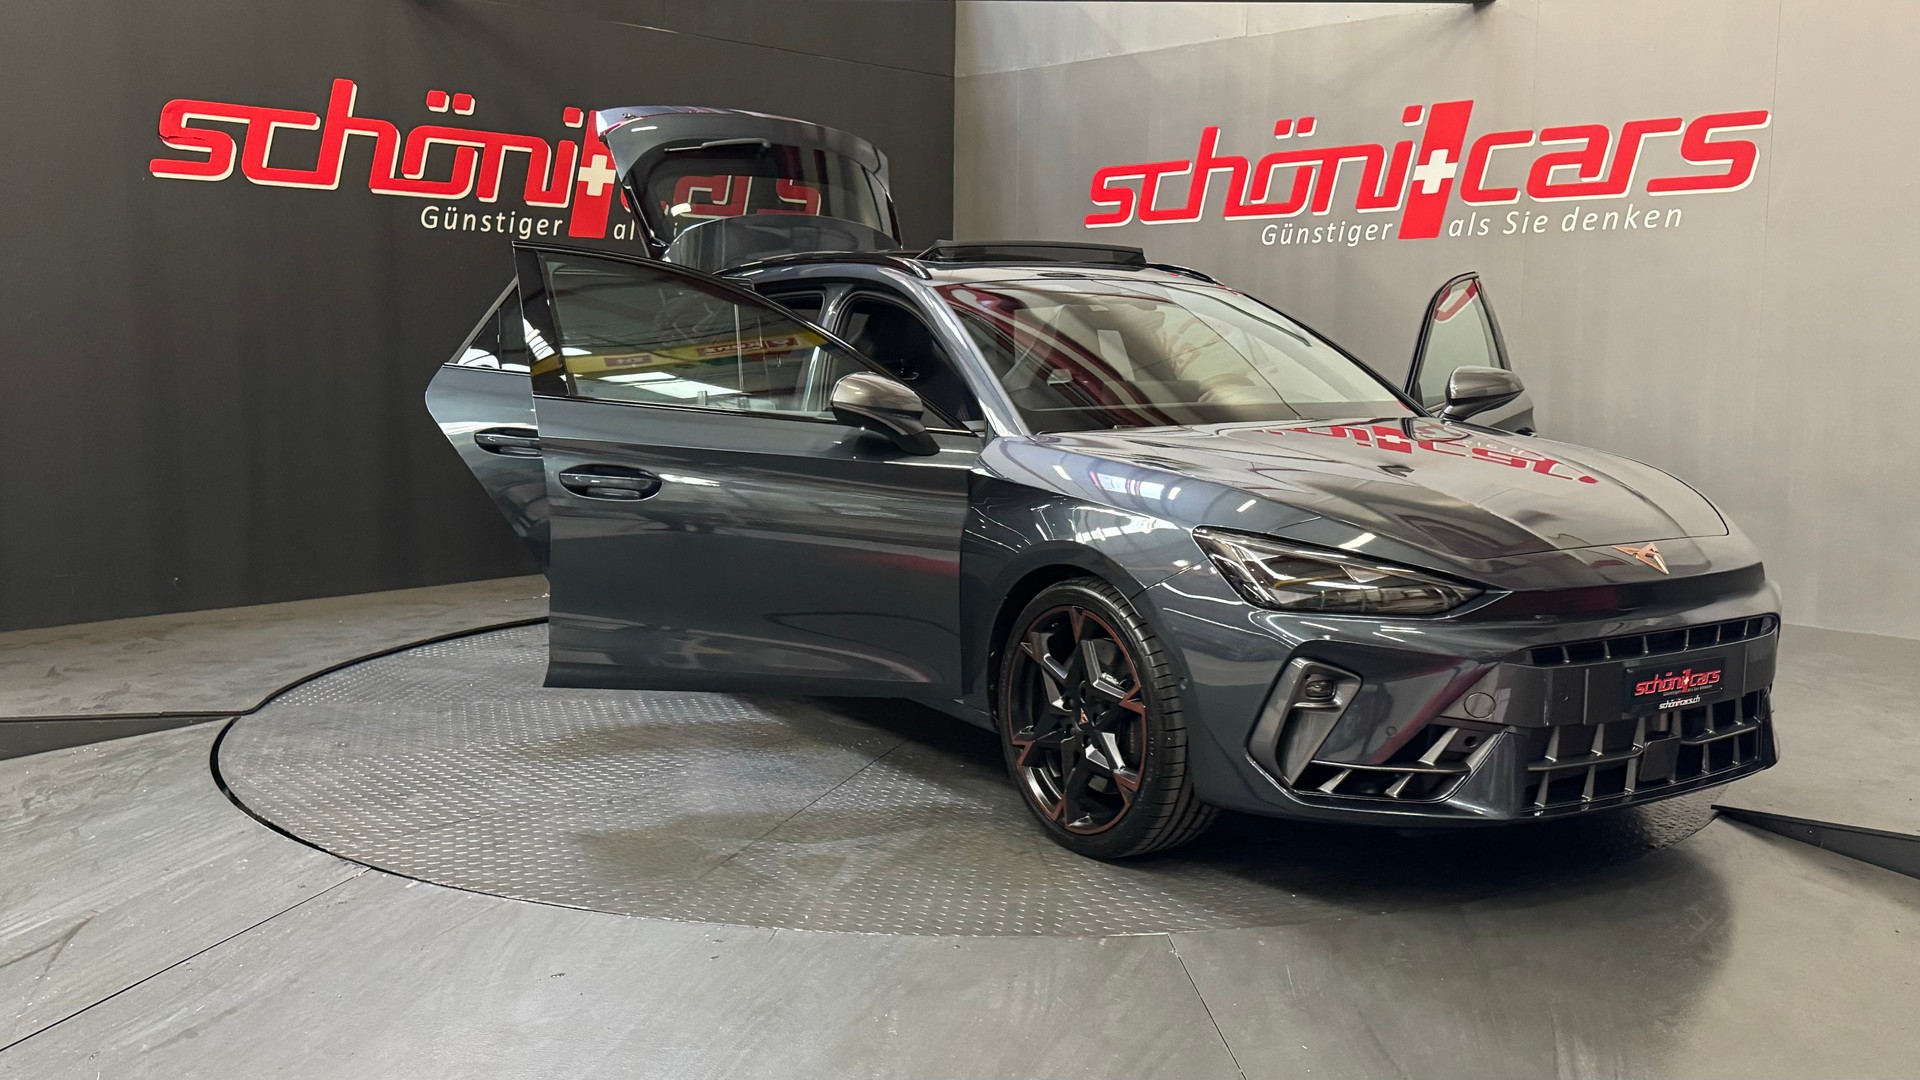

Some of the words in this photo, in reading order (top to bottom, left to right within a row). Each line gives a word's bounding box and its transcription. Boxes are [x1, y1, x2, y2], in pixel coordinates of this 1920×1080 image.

[420, 205, 564, 240] Günstiger
[612, 222, 637, 242] al
[1260, 218, 1394, 248] Günstiger
[1448, 210, 1490, 239] als
[1503, 208, 1548, 236] Sie
[1561, 202, 1683, 233] denken
